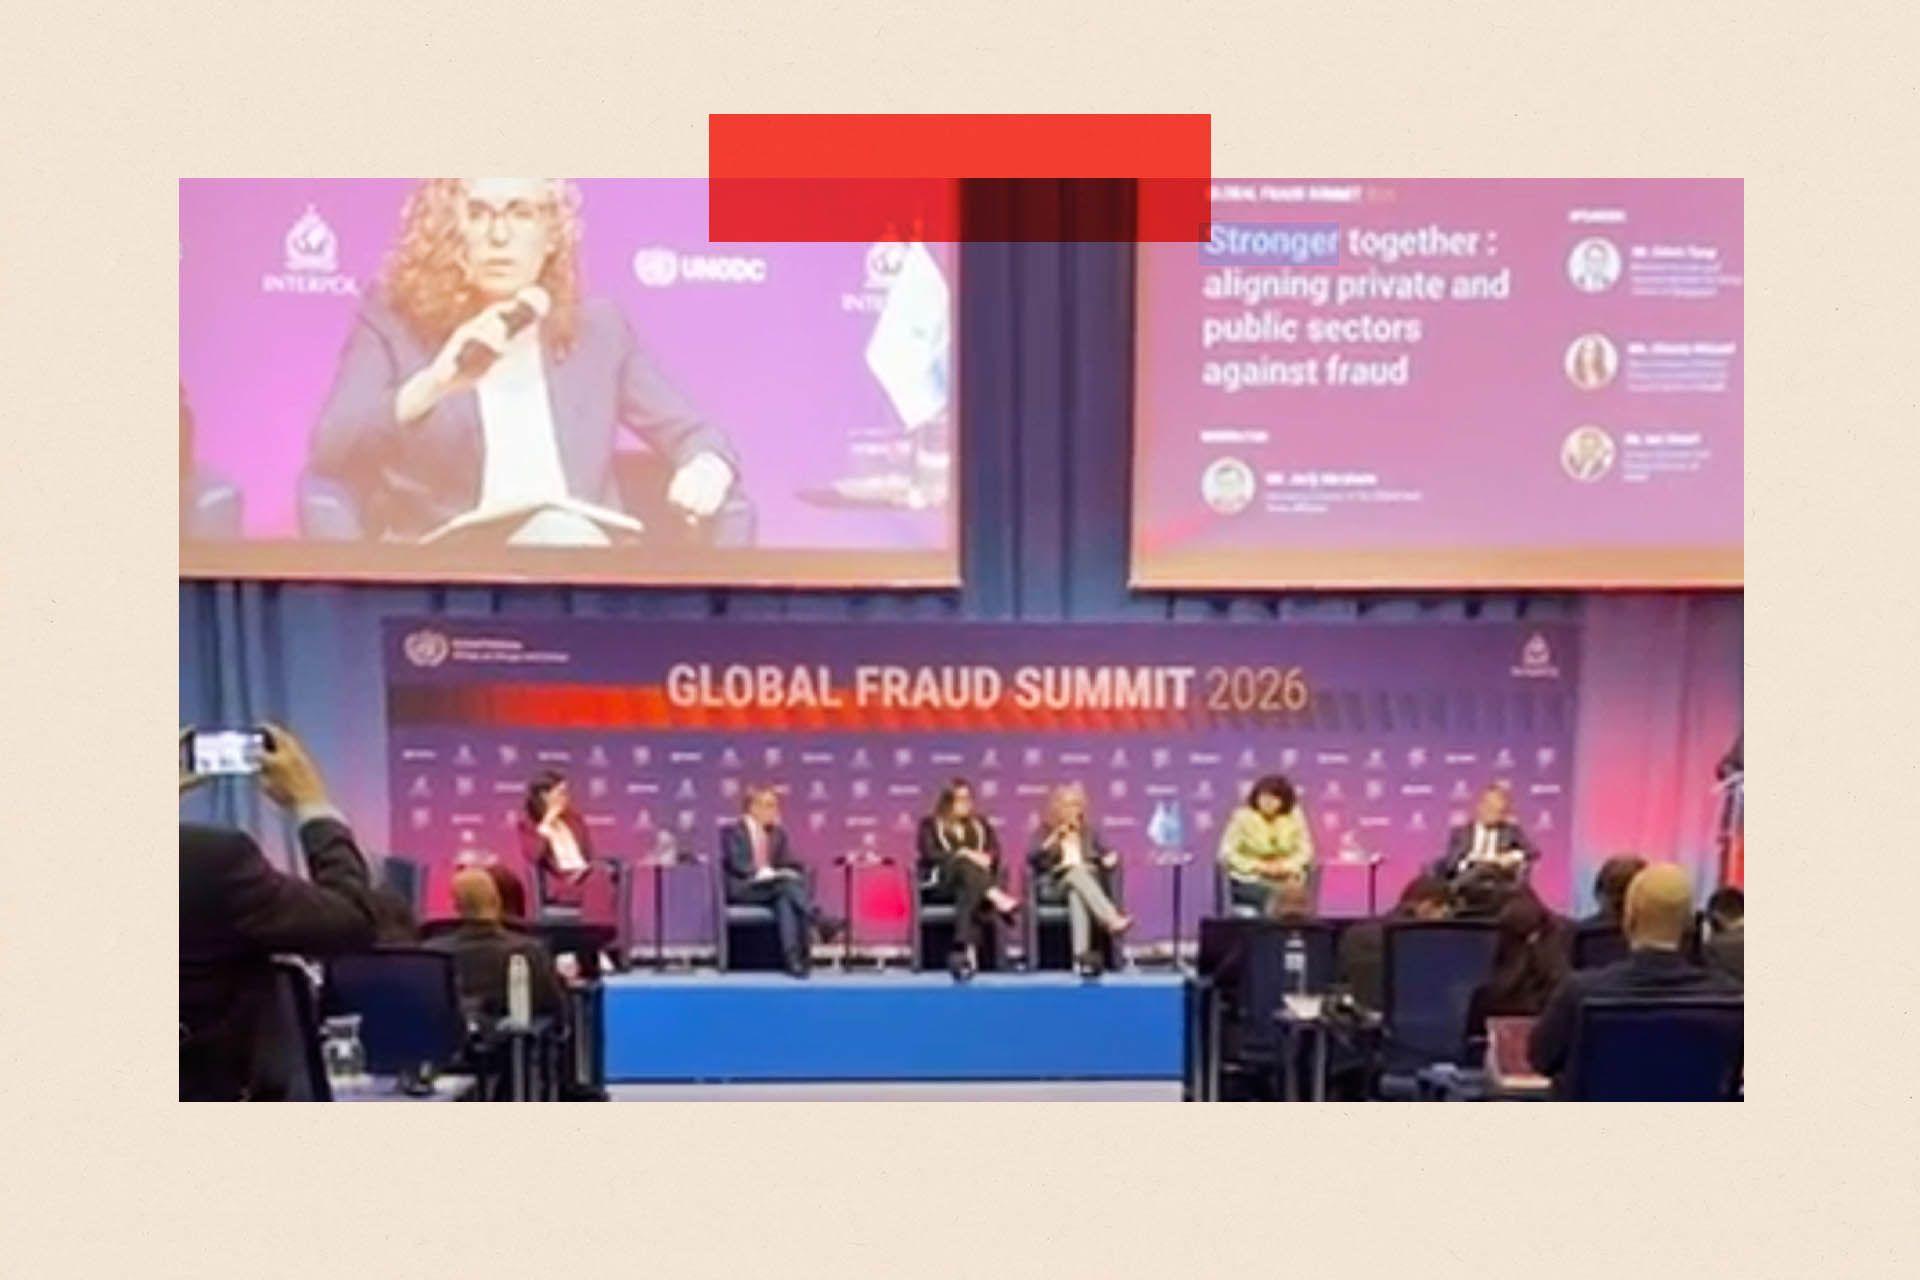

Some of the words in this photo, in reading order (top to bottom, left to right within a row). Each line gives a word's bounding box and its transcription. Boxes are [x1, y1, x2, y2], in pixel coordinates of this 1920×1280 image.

[1205, 224, 1340, 263] Stronger
[1348, 225, 1478, 263] together
[682, 255, 766, 282] UNODC
[1202, 267, 1329, 306] aligning
[1336, 267, 1444, 305] private
[1450, 268, 1510, 300] and
[1203, 312, 1298, 348] public
[1306, 315, 1422, 343] sectors
[1202, 355, 1319, 393] against
[1325, 353, 1410, 385] fraud
[667, 664, 842, 709] GLOBAL
[856, 664, 1003, 709] FRAUD
[1015, 666, 1195, 710] SUMMIT
[1206, 667, 1308, 711] 2026
